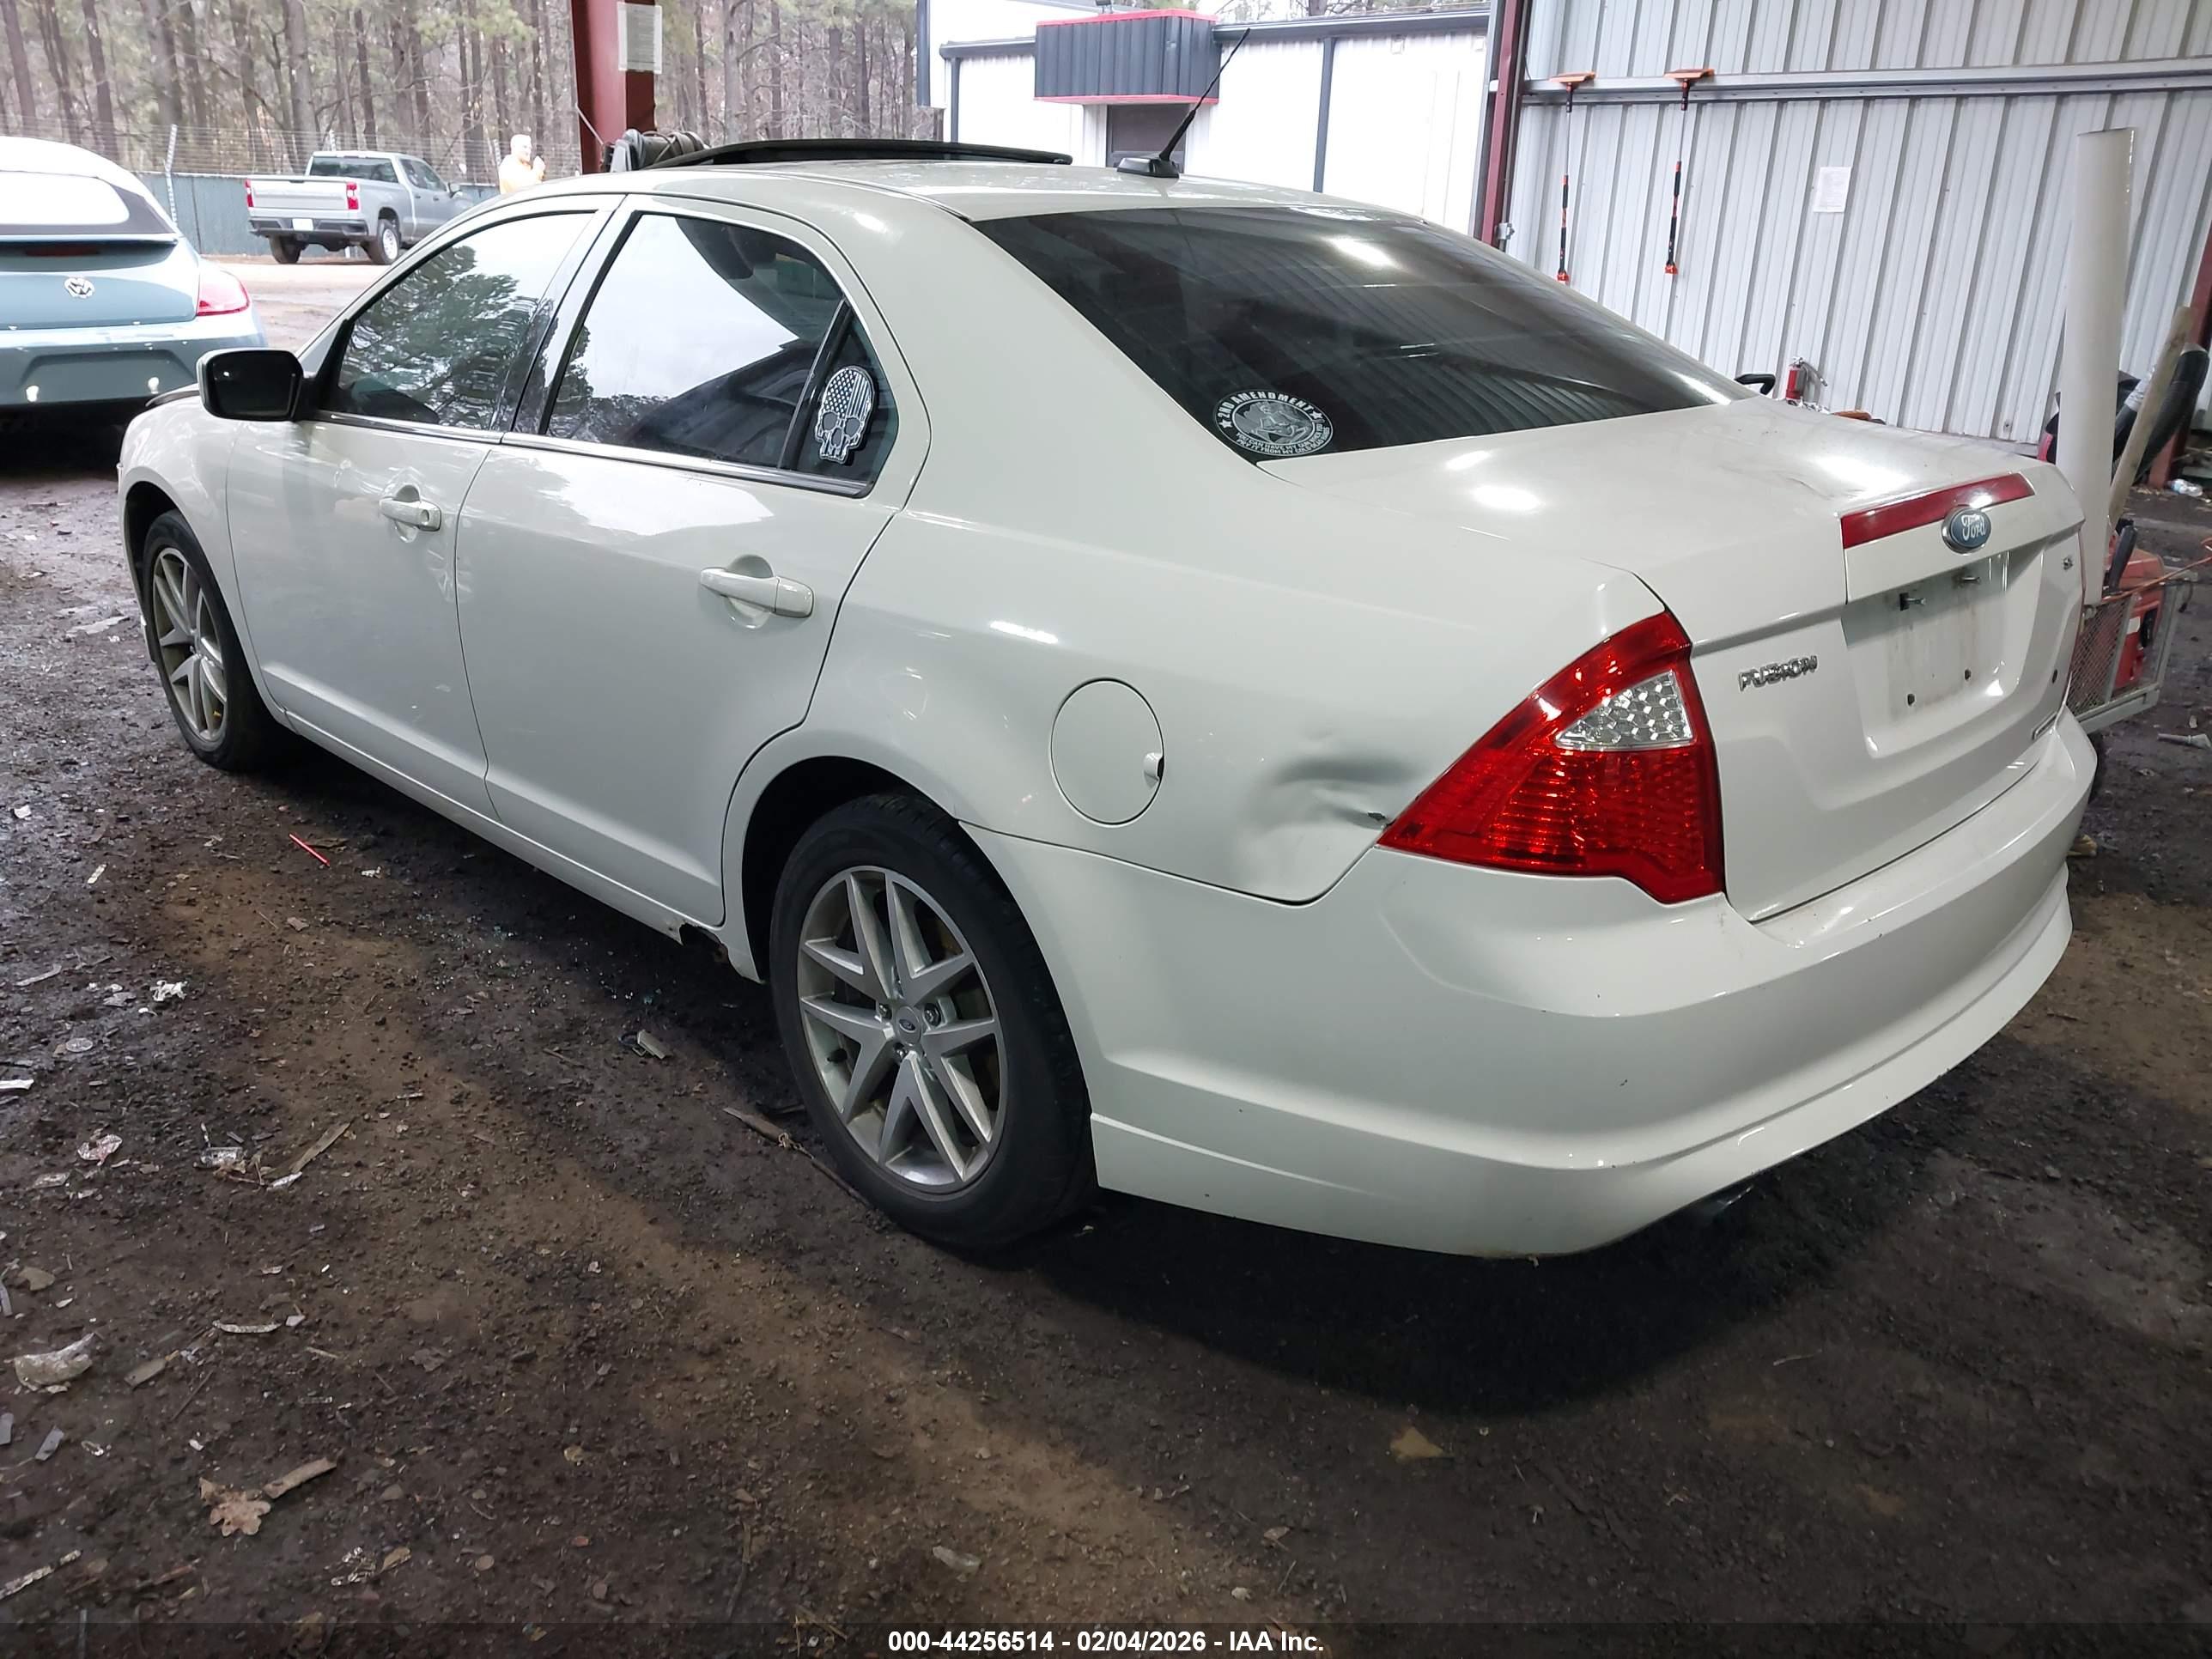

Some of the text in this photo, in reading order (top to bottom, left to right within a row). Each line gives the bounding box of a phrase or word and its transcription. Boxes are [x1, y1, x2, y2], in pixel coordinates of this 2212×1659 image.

[1218, 391, 1315, 419] 2ND AMENDMENT
[1236, 432, 1249, 442] YOU
[1249, 439, 1265, 448] CAN
[1961, 514, 1986, 541] Ford
[1739, 655, 1818, 691] FUSION
